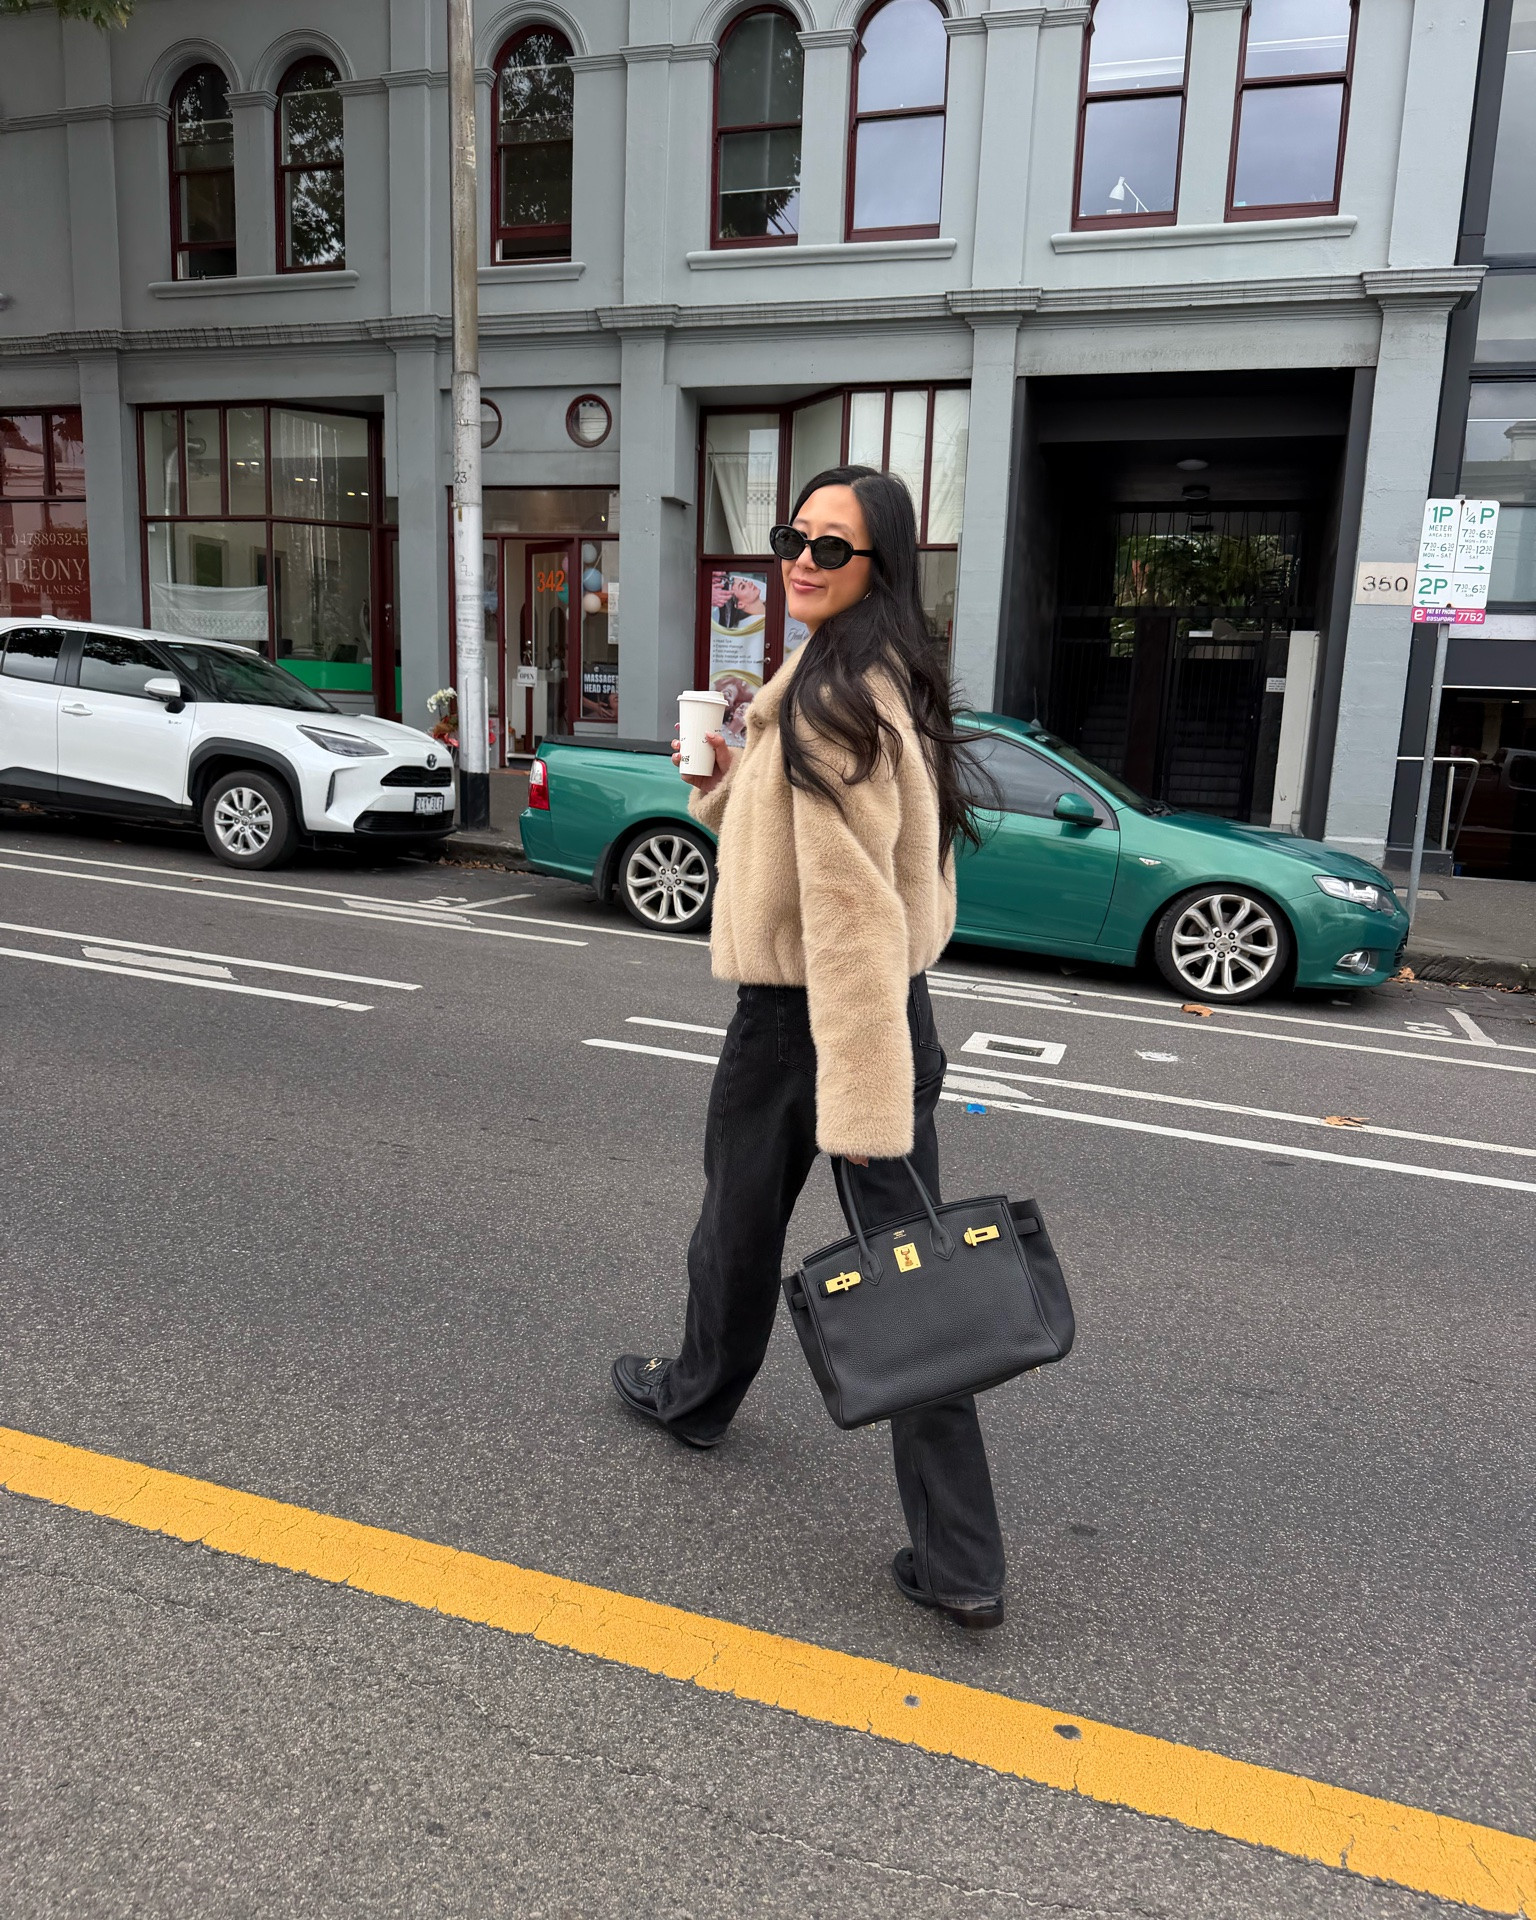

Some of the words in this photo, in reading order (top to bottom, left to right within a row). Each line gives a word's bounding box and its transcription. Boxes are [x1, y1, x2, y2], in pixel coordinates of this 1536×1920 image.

[1433, 506, 1453, 523] 1P
[1480, 508, 1495, 524] P
[15, 558, 86, 581] PEONY
[22, 584, 80, 594] WELLNESS
[536, 570, 565, 592] 342
[1363, 576, 1408, 592] 350
[1418, 578, 1448, 595] 2P
[1457, 613, 1483, 622] 7752
[584, 683, 601, 693] HEAD
